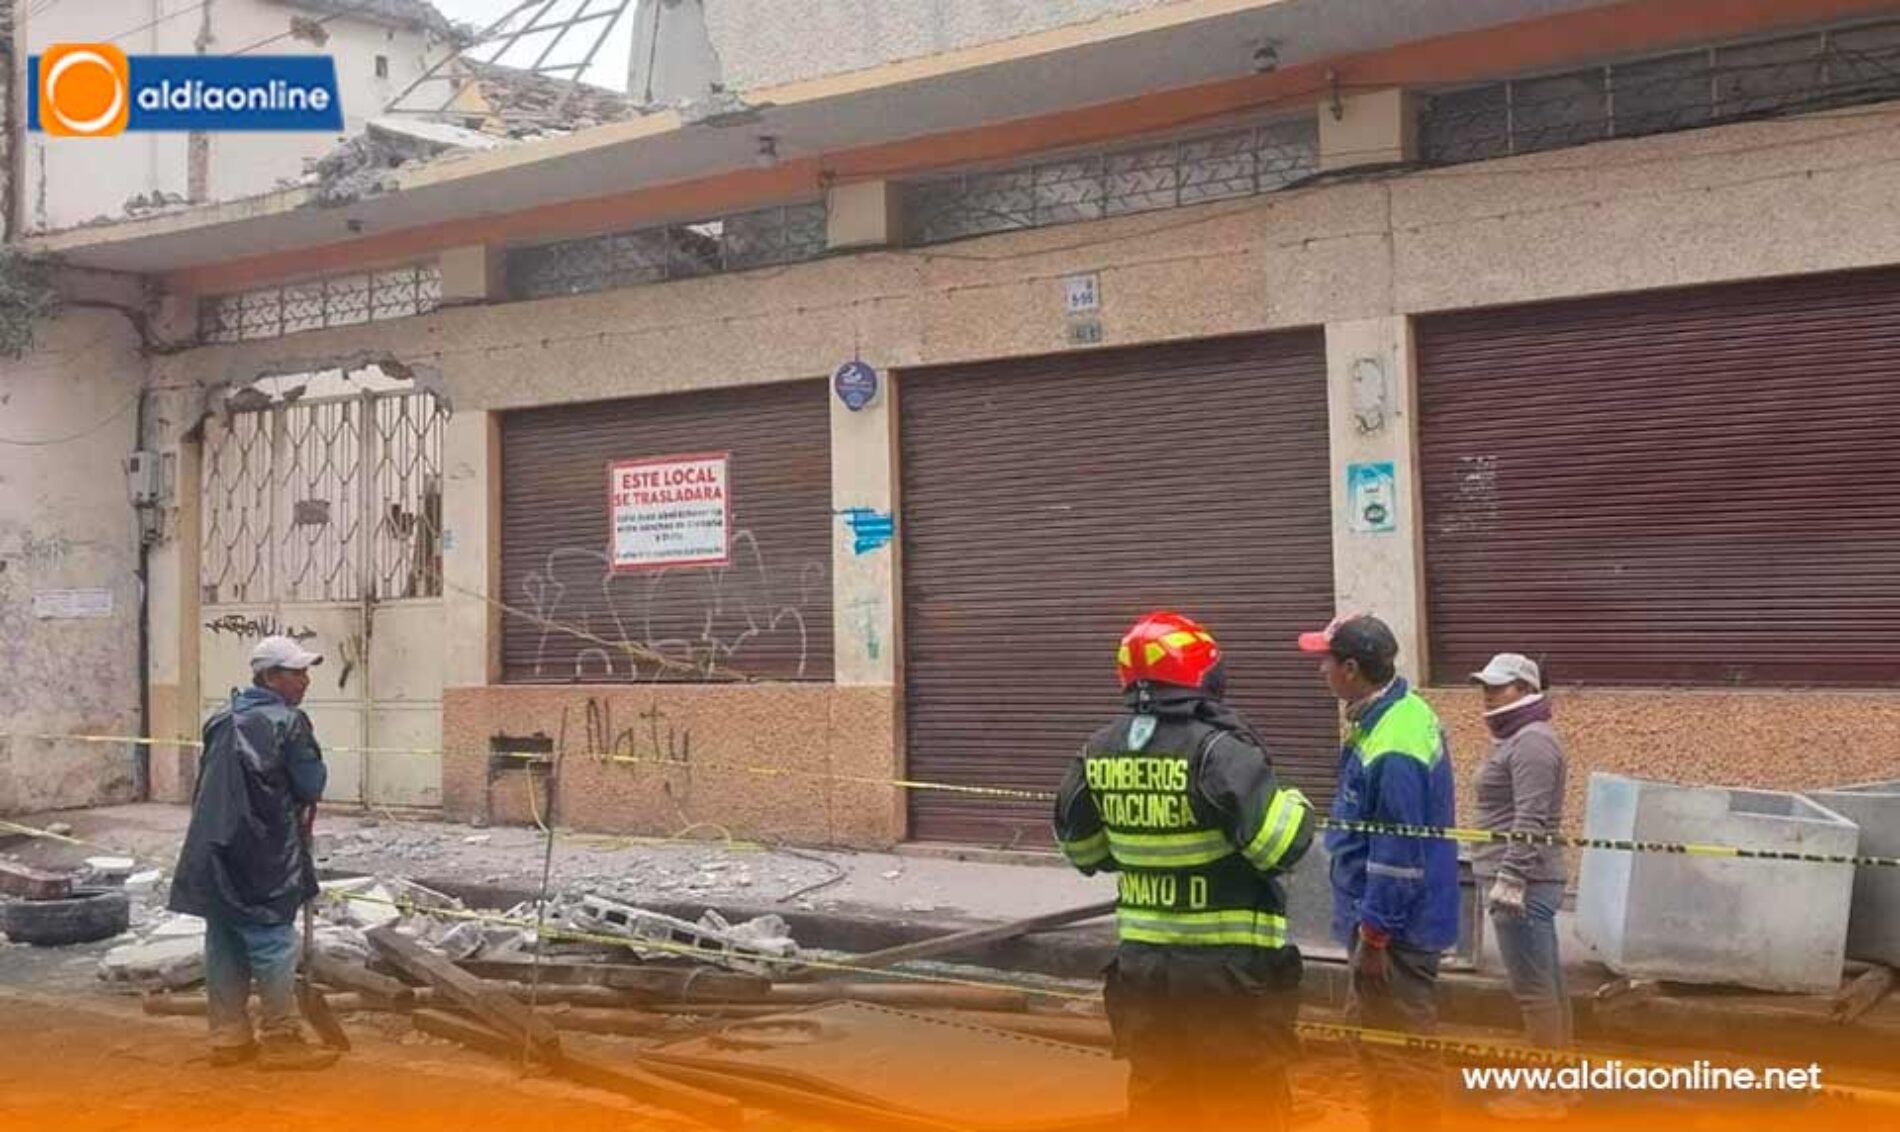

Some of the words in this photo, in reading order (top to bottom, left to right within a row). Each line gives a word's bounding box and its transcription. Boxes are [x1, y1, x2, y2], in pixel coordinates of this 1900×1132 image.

[623, 471, 659, 489] ESTE
[664, 467, 716, 485] LOCAL
[1087, 757, 1188, 791] BOMBEROS
[1190, 876, 1206, 908] D
